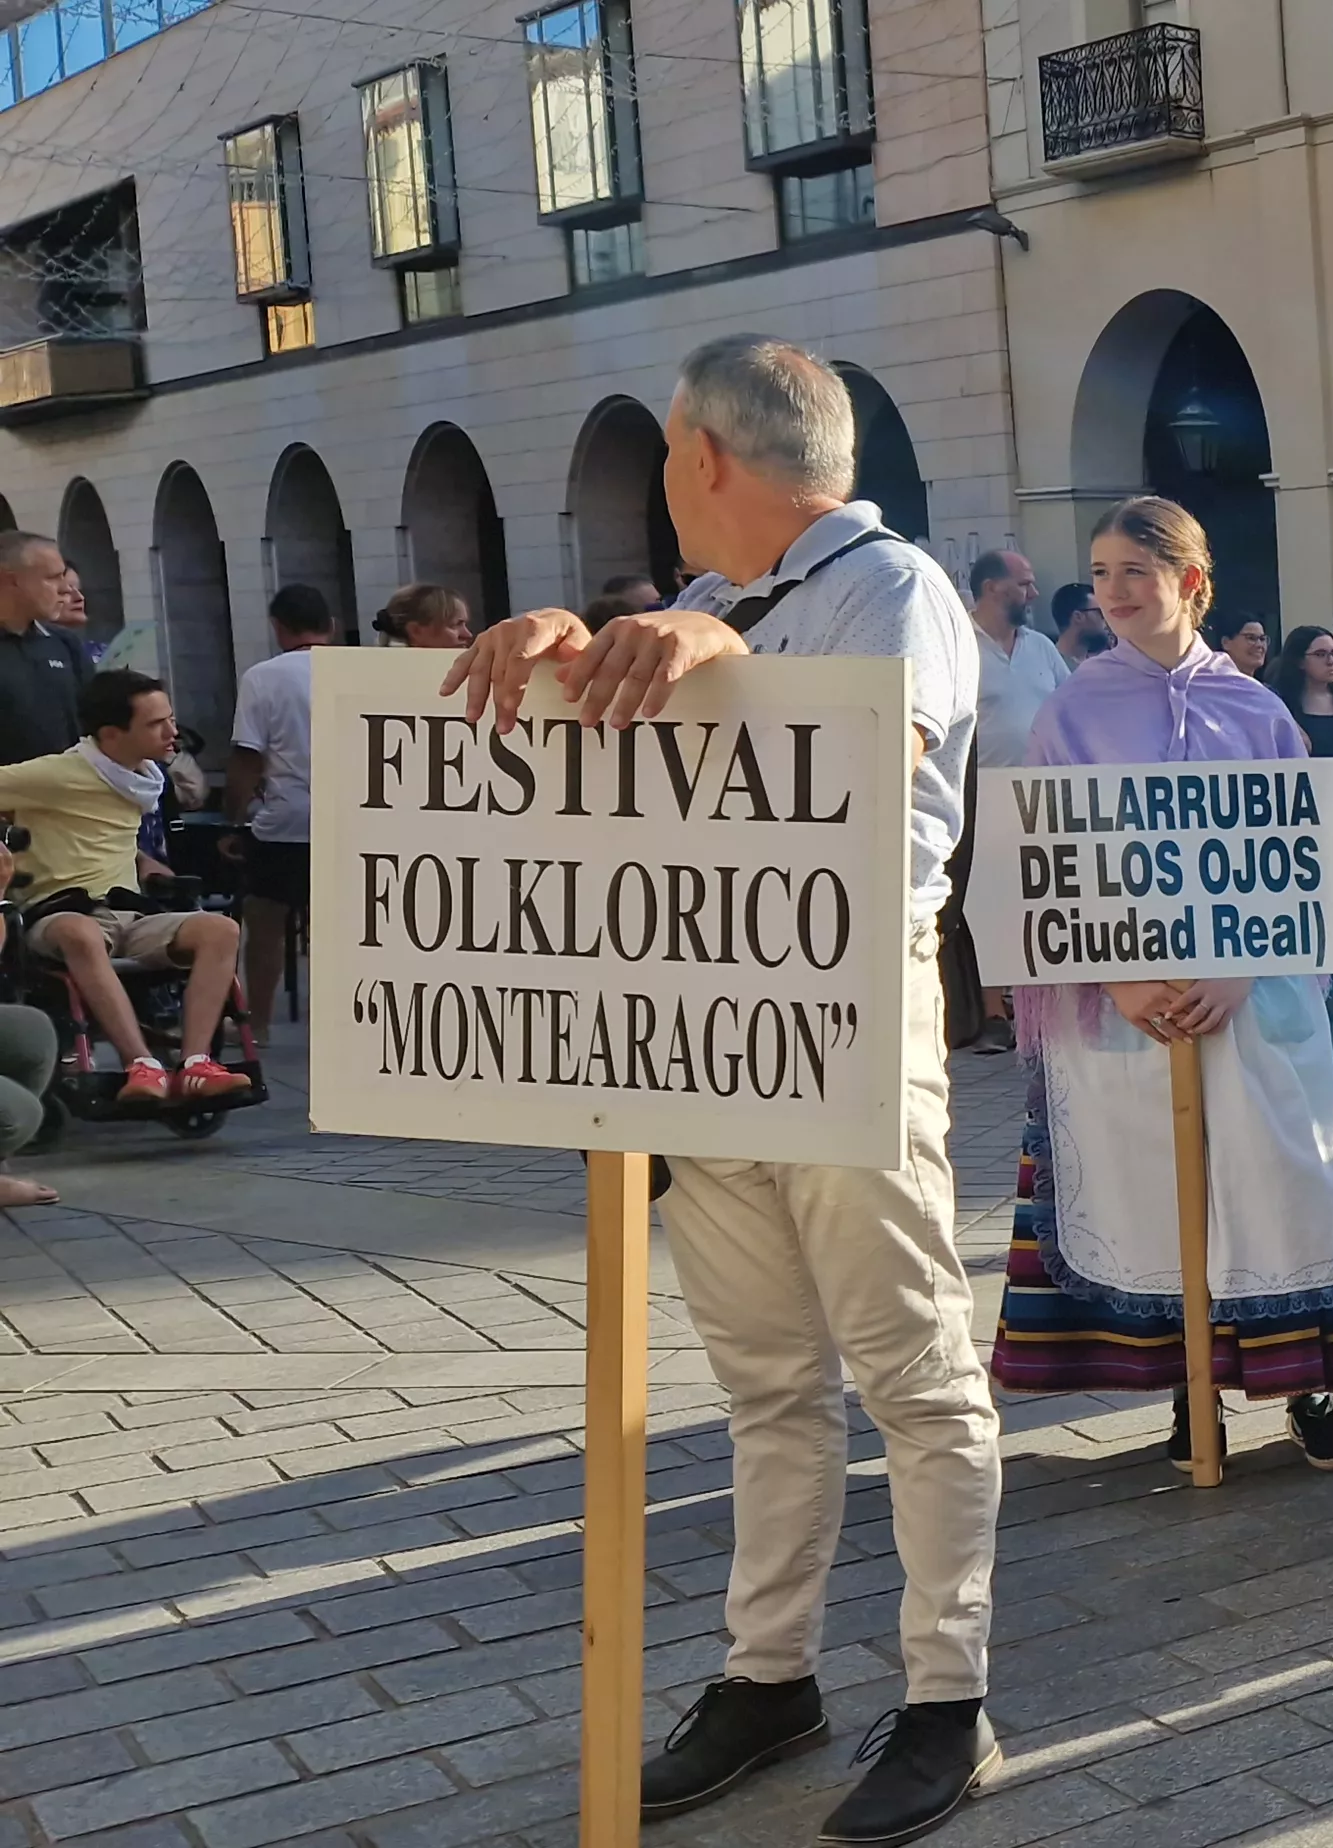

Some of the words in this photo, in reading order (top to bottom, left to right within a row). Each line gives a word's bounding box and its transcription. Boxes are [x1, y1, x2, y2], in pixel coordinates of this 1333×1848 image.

[359, 713, 852, 824] FESTIVAL
[1011, 771, 1321, 835] VILLARRUBIA
[358, 852, 851, 971] FOLKLORICO
[1019, 843, 1082, 900] DE
[1095, 839, 1184, 898] LOS
[1199, 835, 1322, 896] OJOS
[1022, 904, 1198, 978] (Ciudad
[1210, 900, 1326, 968] Real)
[353, 977, 858, 1103] “MONTEARAGON”
